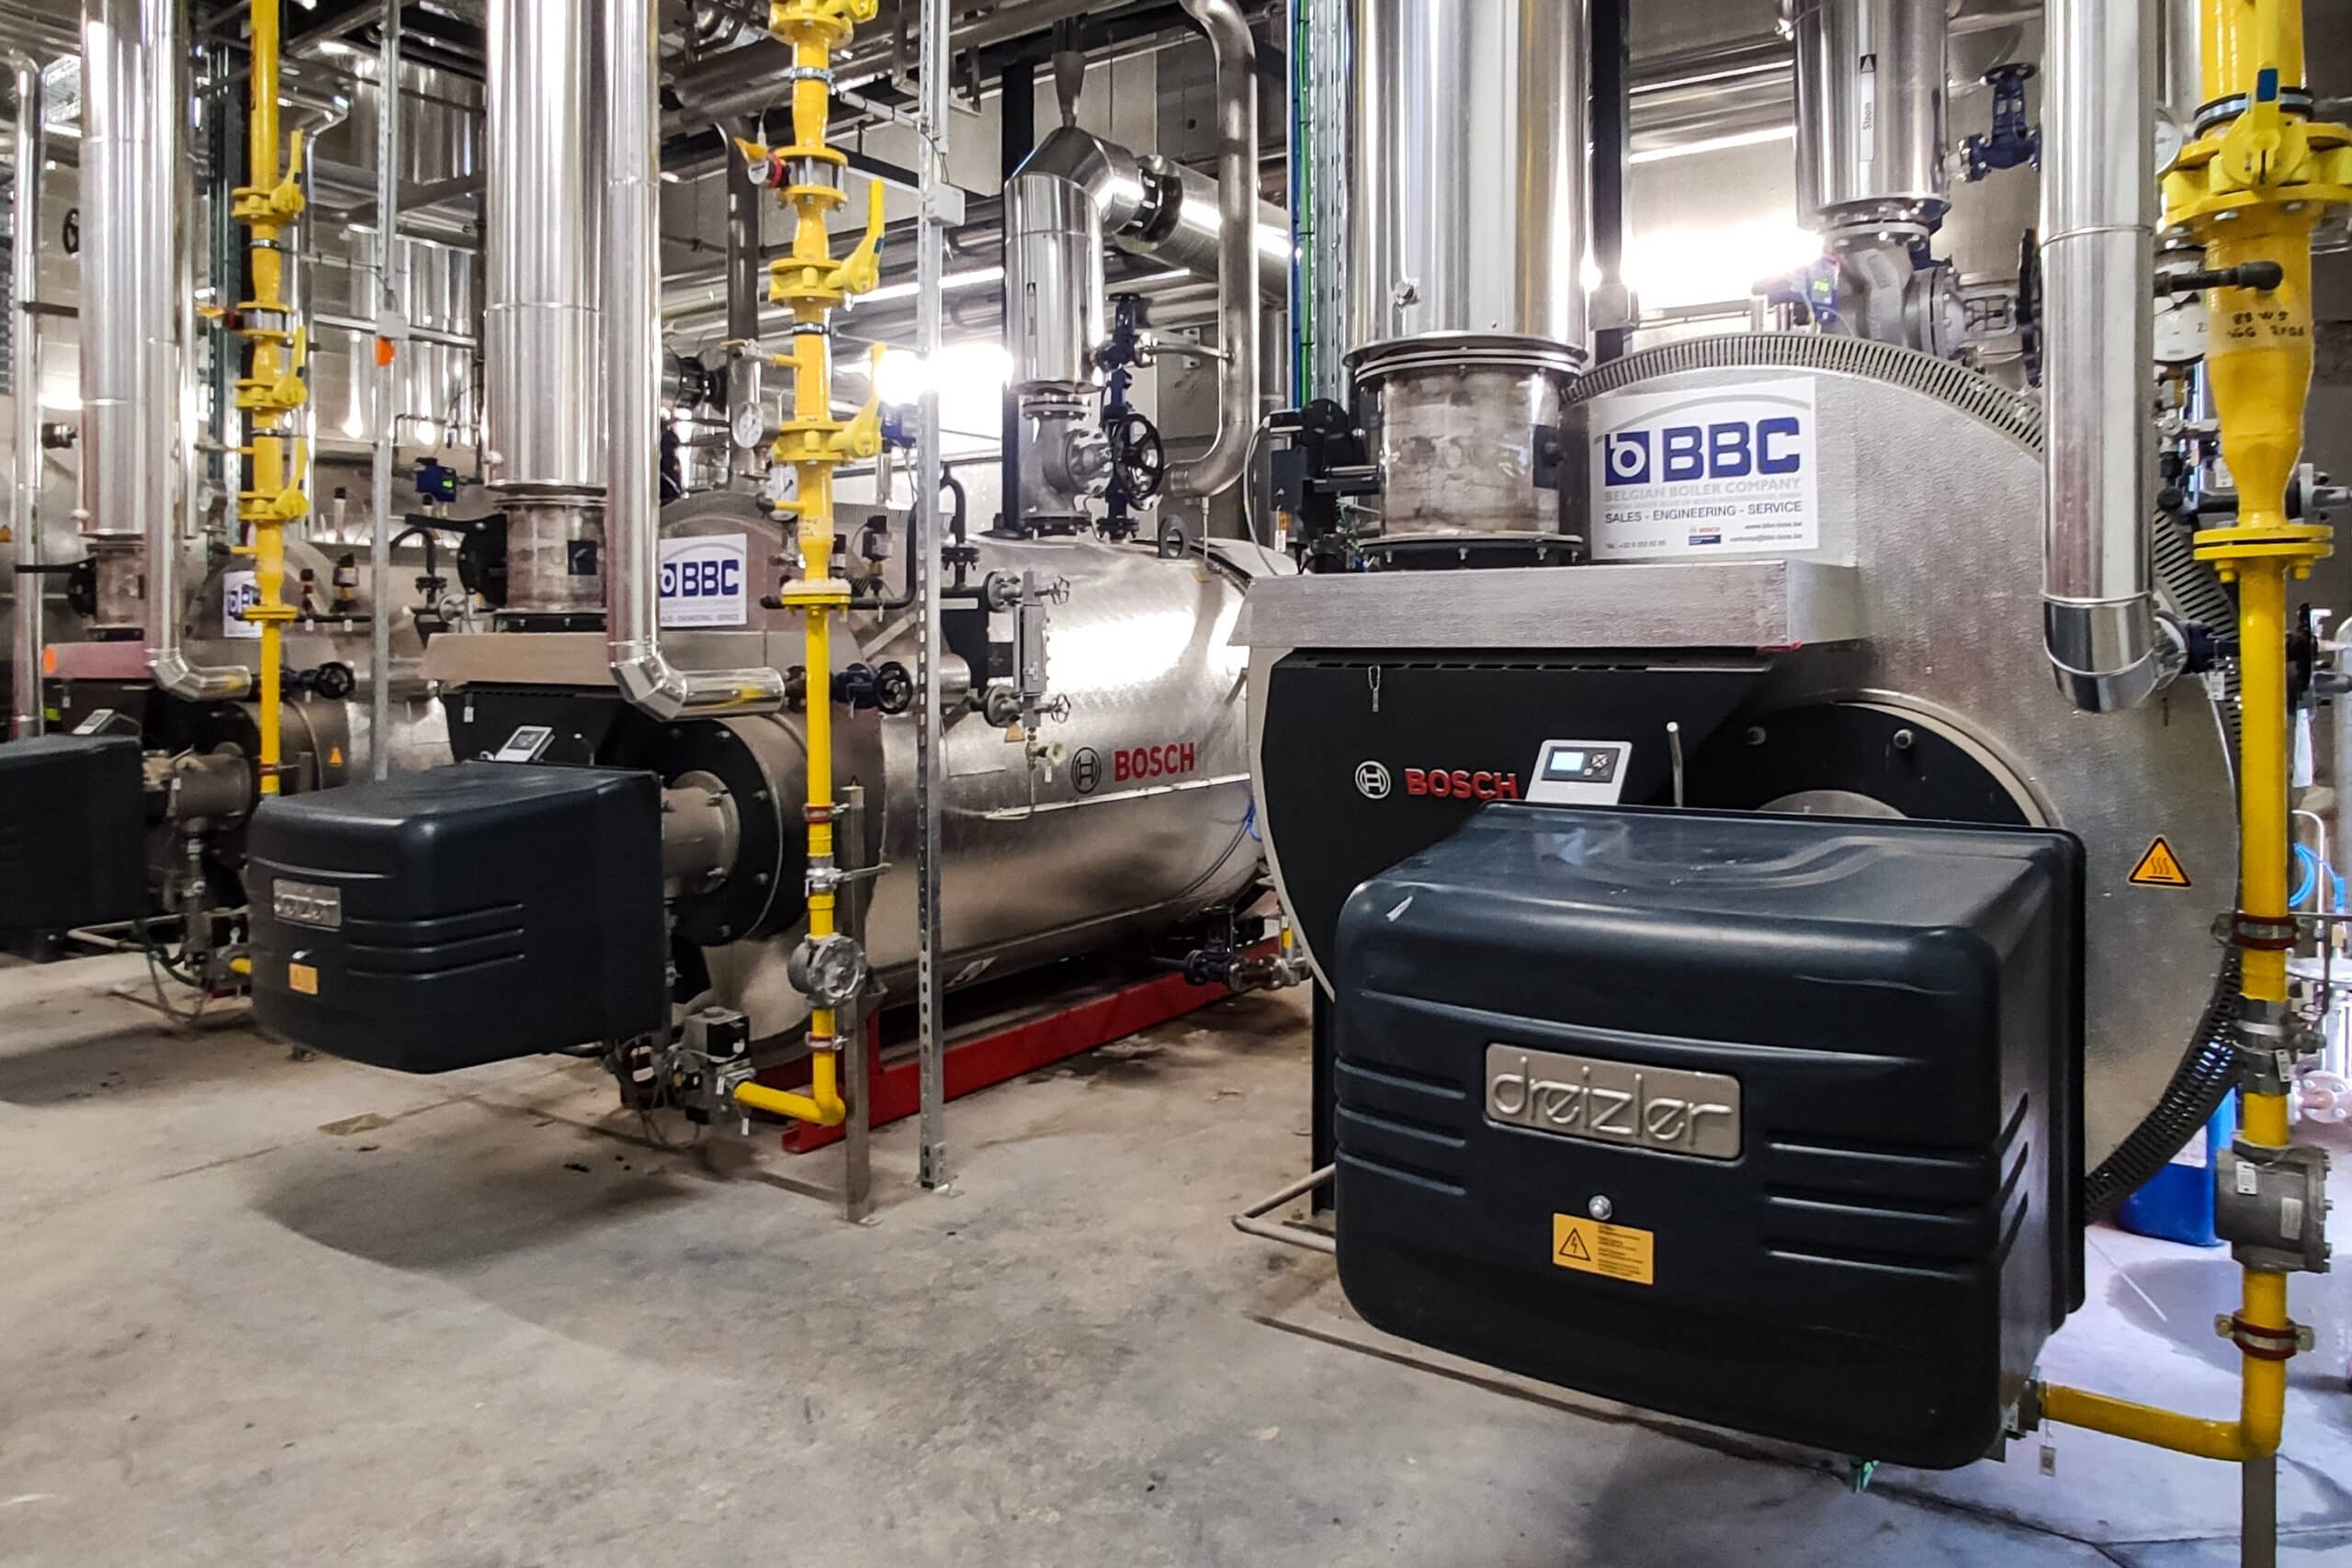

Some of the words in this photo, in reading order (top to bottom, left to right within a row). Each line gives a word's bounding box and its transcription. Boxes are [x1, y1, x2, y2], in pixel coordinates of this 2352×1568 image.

[1662, 417, 1801, 483] BBC
[1604, 489, 1665, 502] BELGIAN
[1669, 482, 1721, 498] BOILER
[1725, 477, 1802, 493] COMPANY
[1605, 511, 1642, 524] SALES
[1653, 504, 1736, 521] ENGINEERING
[1747, 501, 1803, 515] SERVICE
[682, 559, 739, 597] BBC
[1114, 742, 1194, 782] BOSCH
[1404, 768, 1519, 799] BOSCH
[1493, 1055, 1734, 1147] dreizler
